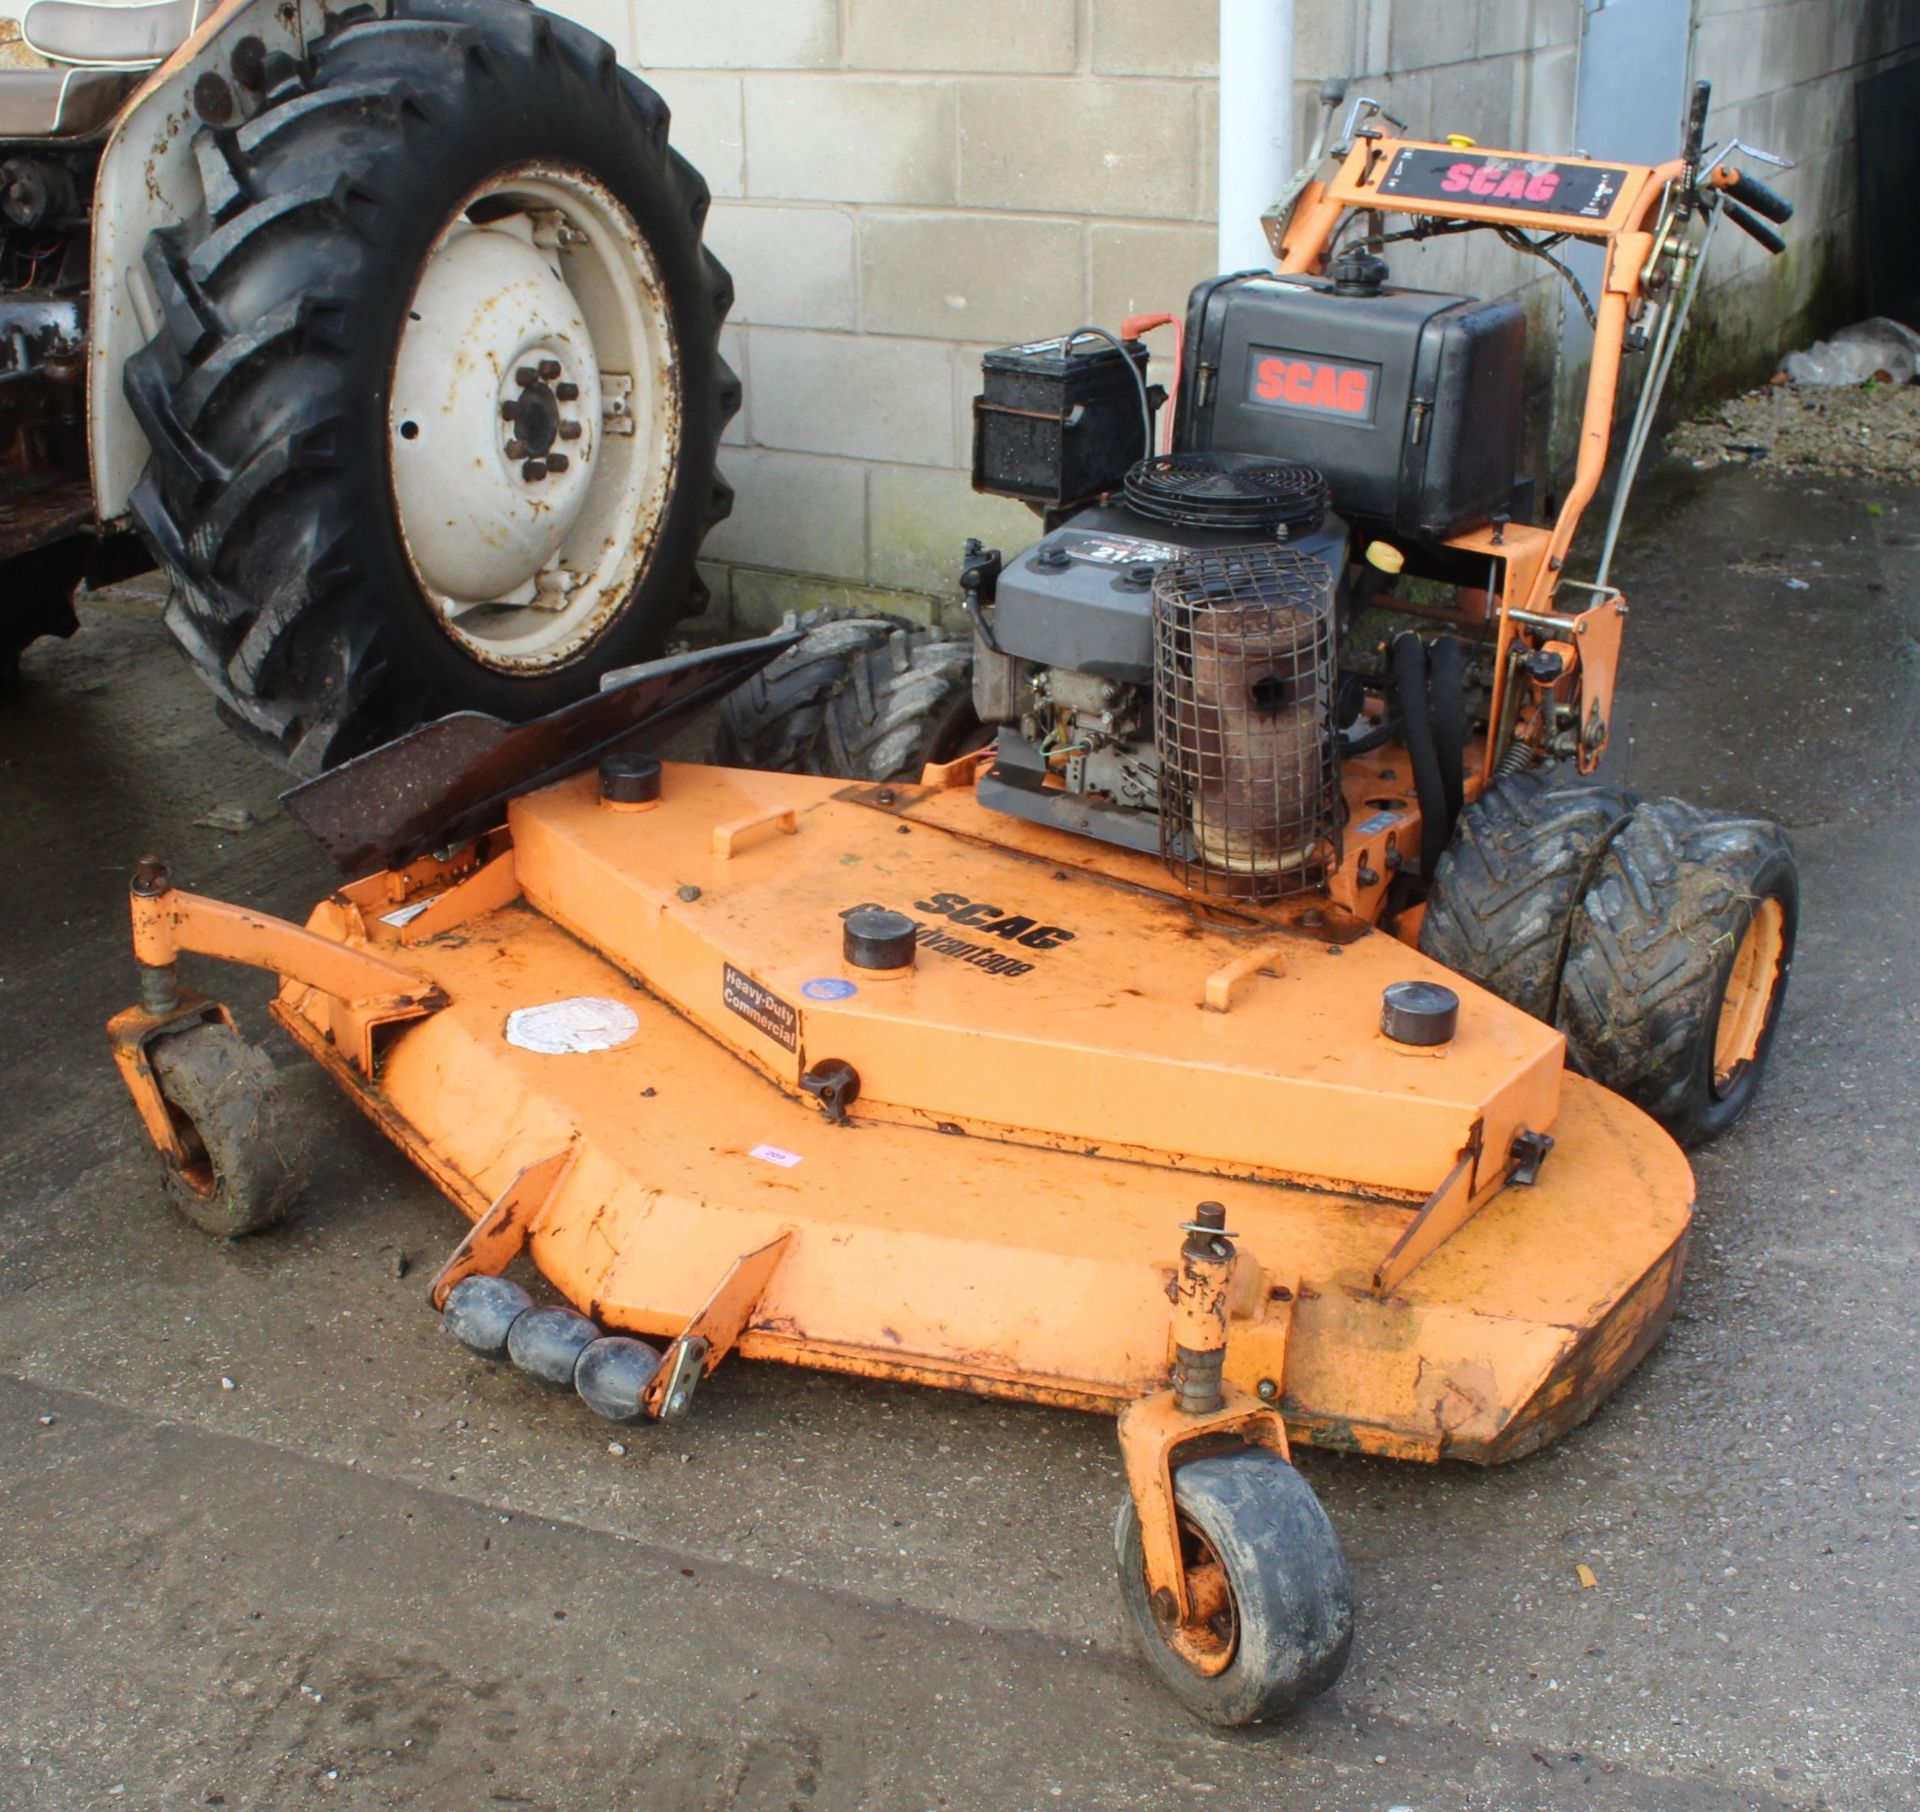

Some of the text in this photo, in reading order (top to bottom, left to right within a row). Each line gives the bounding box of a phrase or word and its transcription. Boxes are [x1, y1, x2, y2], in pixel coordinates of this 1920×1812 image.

[1440, 163, 1561, 202] SCAG
[1256, 358, 1369, 413] SCAG
[913, 892, 1076, 949] SCAG
[915, 922, 1036, 978] dvantage
[724, 987, 796, 1047] Commercial
[725, 968, 794, 1026] Heavy-Duty
